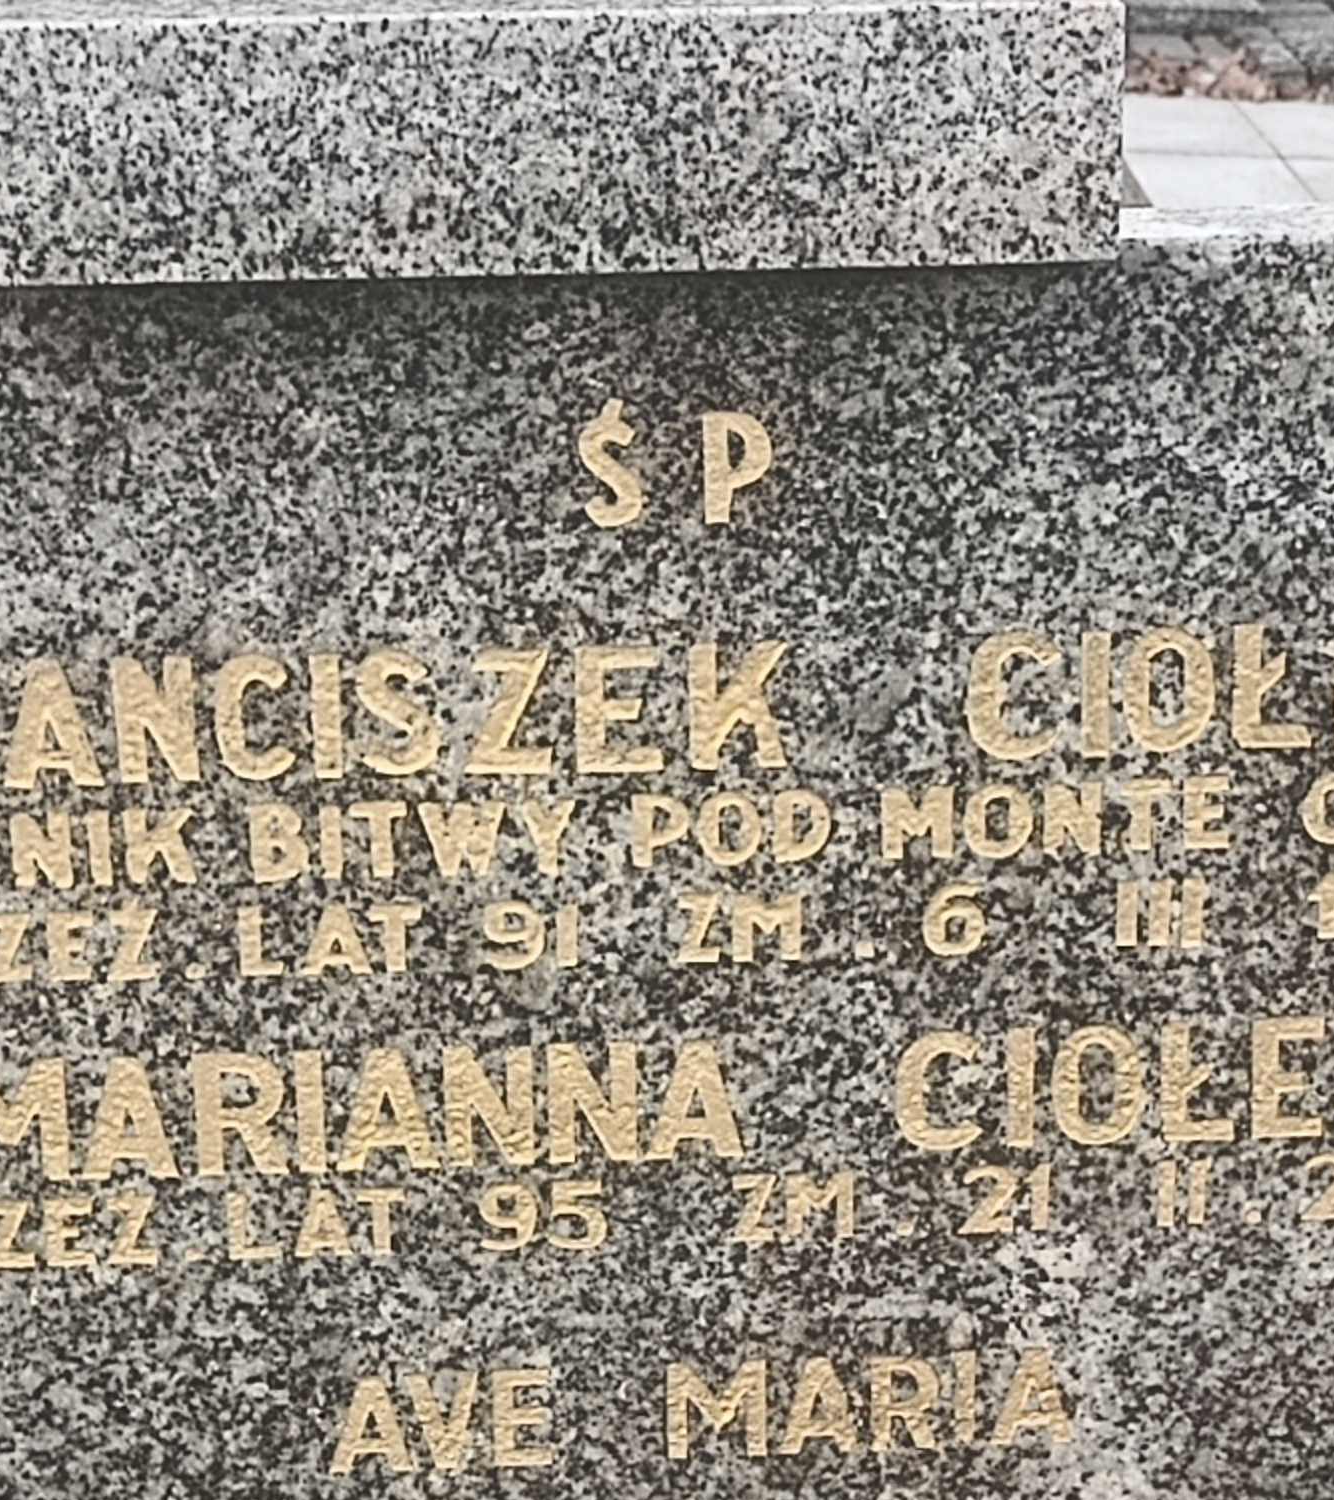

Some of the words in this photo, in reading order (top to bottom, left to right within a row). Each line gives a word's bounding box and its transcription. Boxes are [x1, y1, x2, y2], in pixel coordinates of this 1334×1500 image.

[578, 398, 643, 528] Ś
[702, 410, 772, 525] P
[247, 797, 573, 884] BITWY
[629, 790, 834, 868] POD
[881, 774, 1233, 860] MONTE
[237, 900, 423, 978] LAT
[482, 896, 579, 970] 91
[922, 880, 986, 957] 6
[1115, 876, 1208, 948] III
[226, 1188, 405, 1261] LAT
[476, 1178, 609, 1252] 95
[958, 1161, 1053, 1236] 21
[330, 1364, 553, 1474] AVE
[667, 1345, 1071, 1462] MARIA
